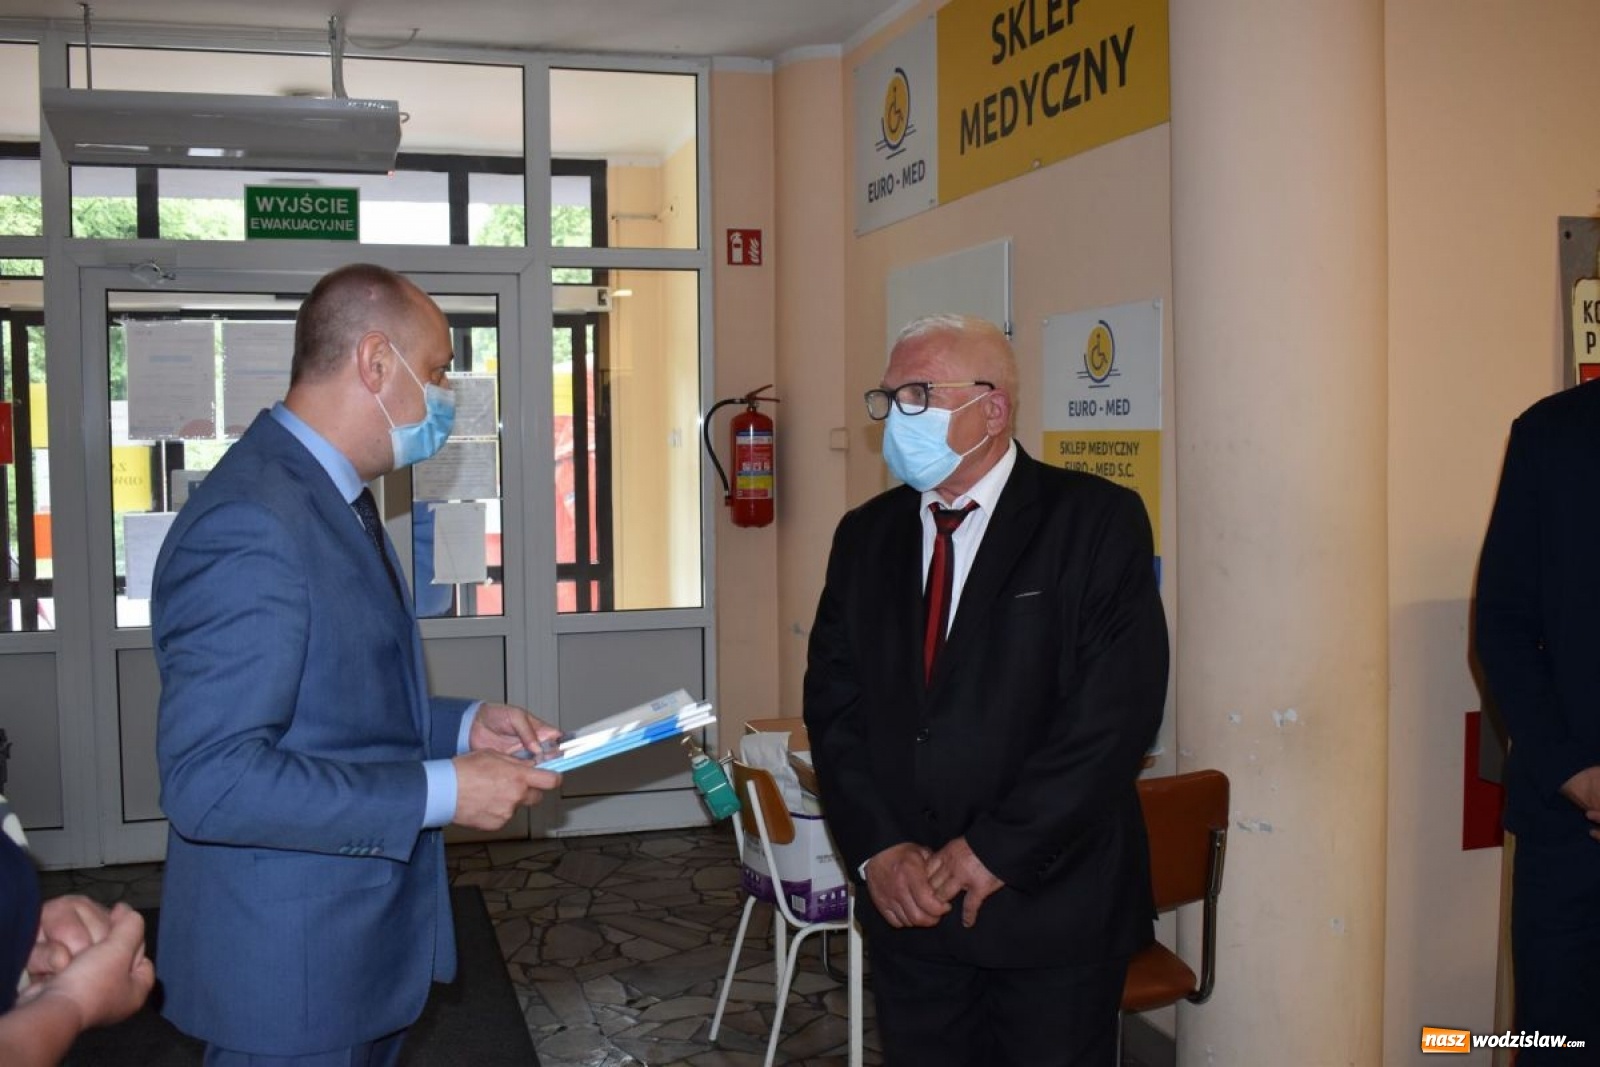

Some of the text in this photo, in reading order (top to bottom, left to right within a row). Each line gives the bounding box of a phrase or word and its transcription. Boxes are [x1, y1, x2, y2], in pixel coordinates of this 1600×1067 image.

[960, 25, 1136, 156] MEDYCZNY
[867, 175, 894, 204] EURO
[902, 160, 926, 189] MED
[255, 192, 349, 214] WYJŚCIE
[250, 217, 355, 232] EWAKUACYJNE
[1586, 331, 1597, 355] P
[1068, 400, 1097, 417] EURO
[1106, 399, 1130, 416] MED
[1059, 440, 1140, 456] SKLEP MEDYCZNY
[1095, 462, 1116, 477] MED
[1118, 462, 1134, 478] S.C.
